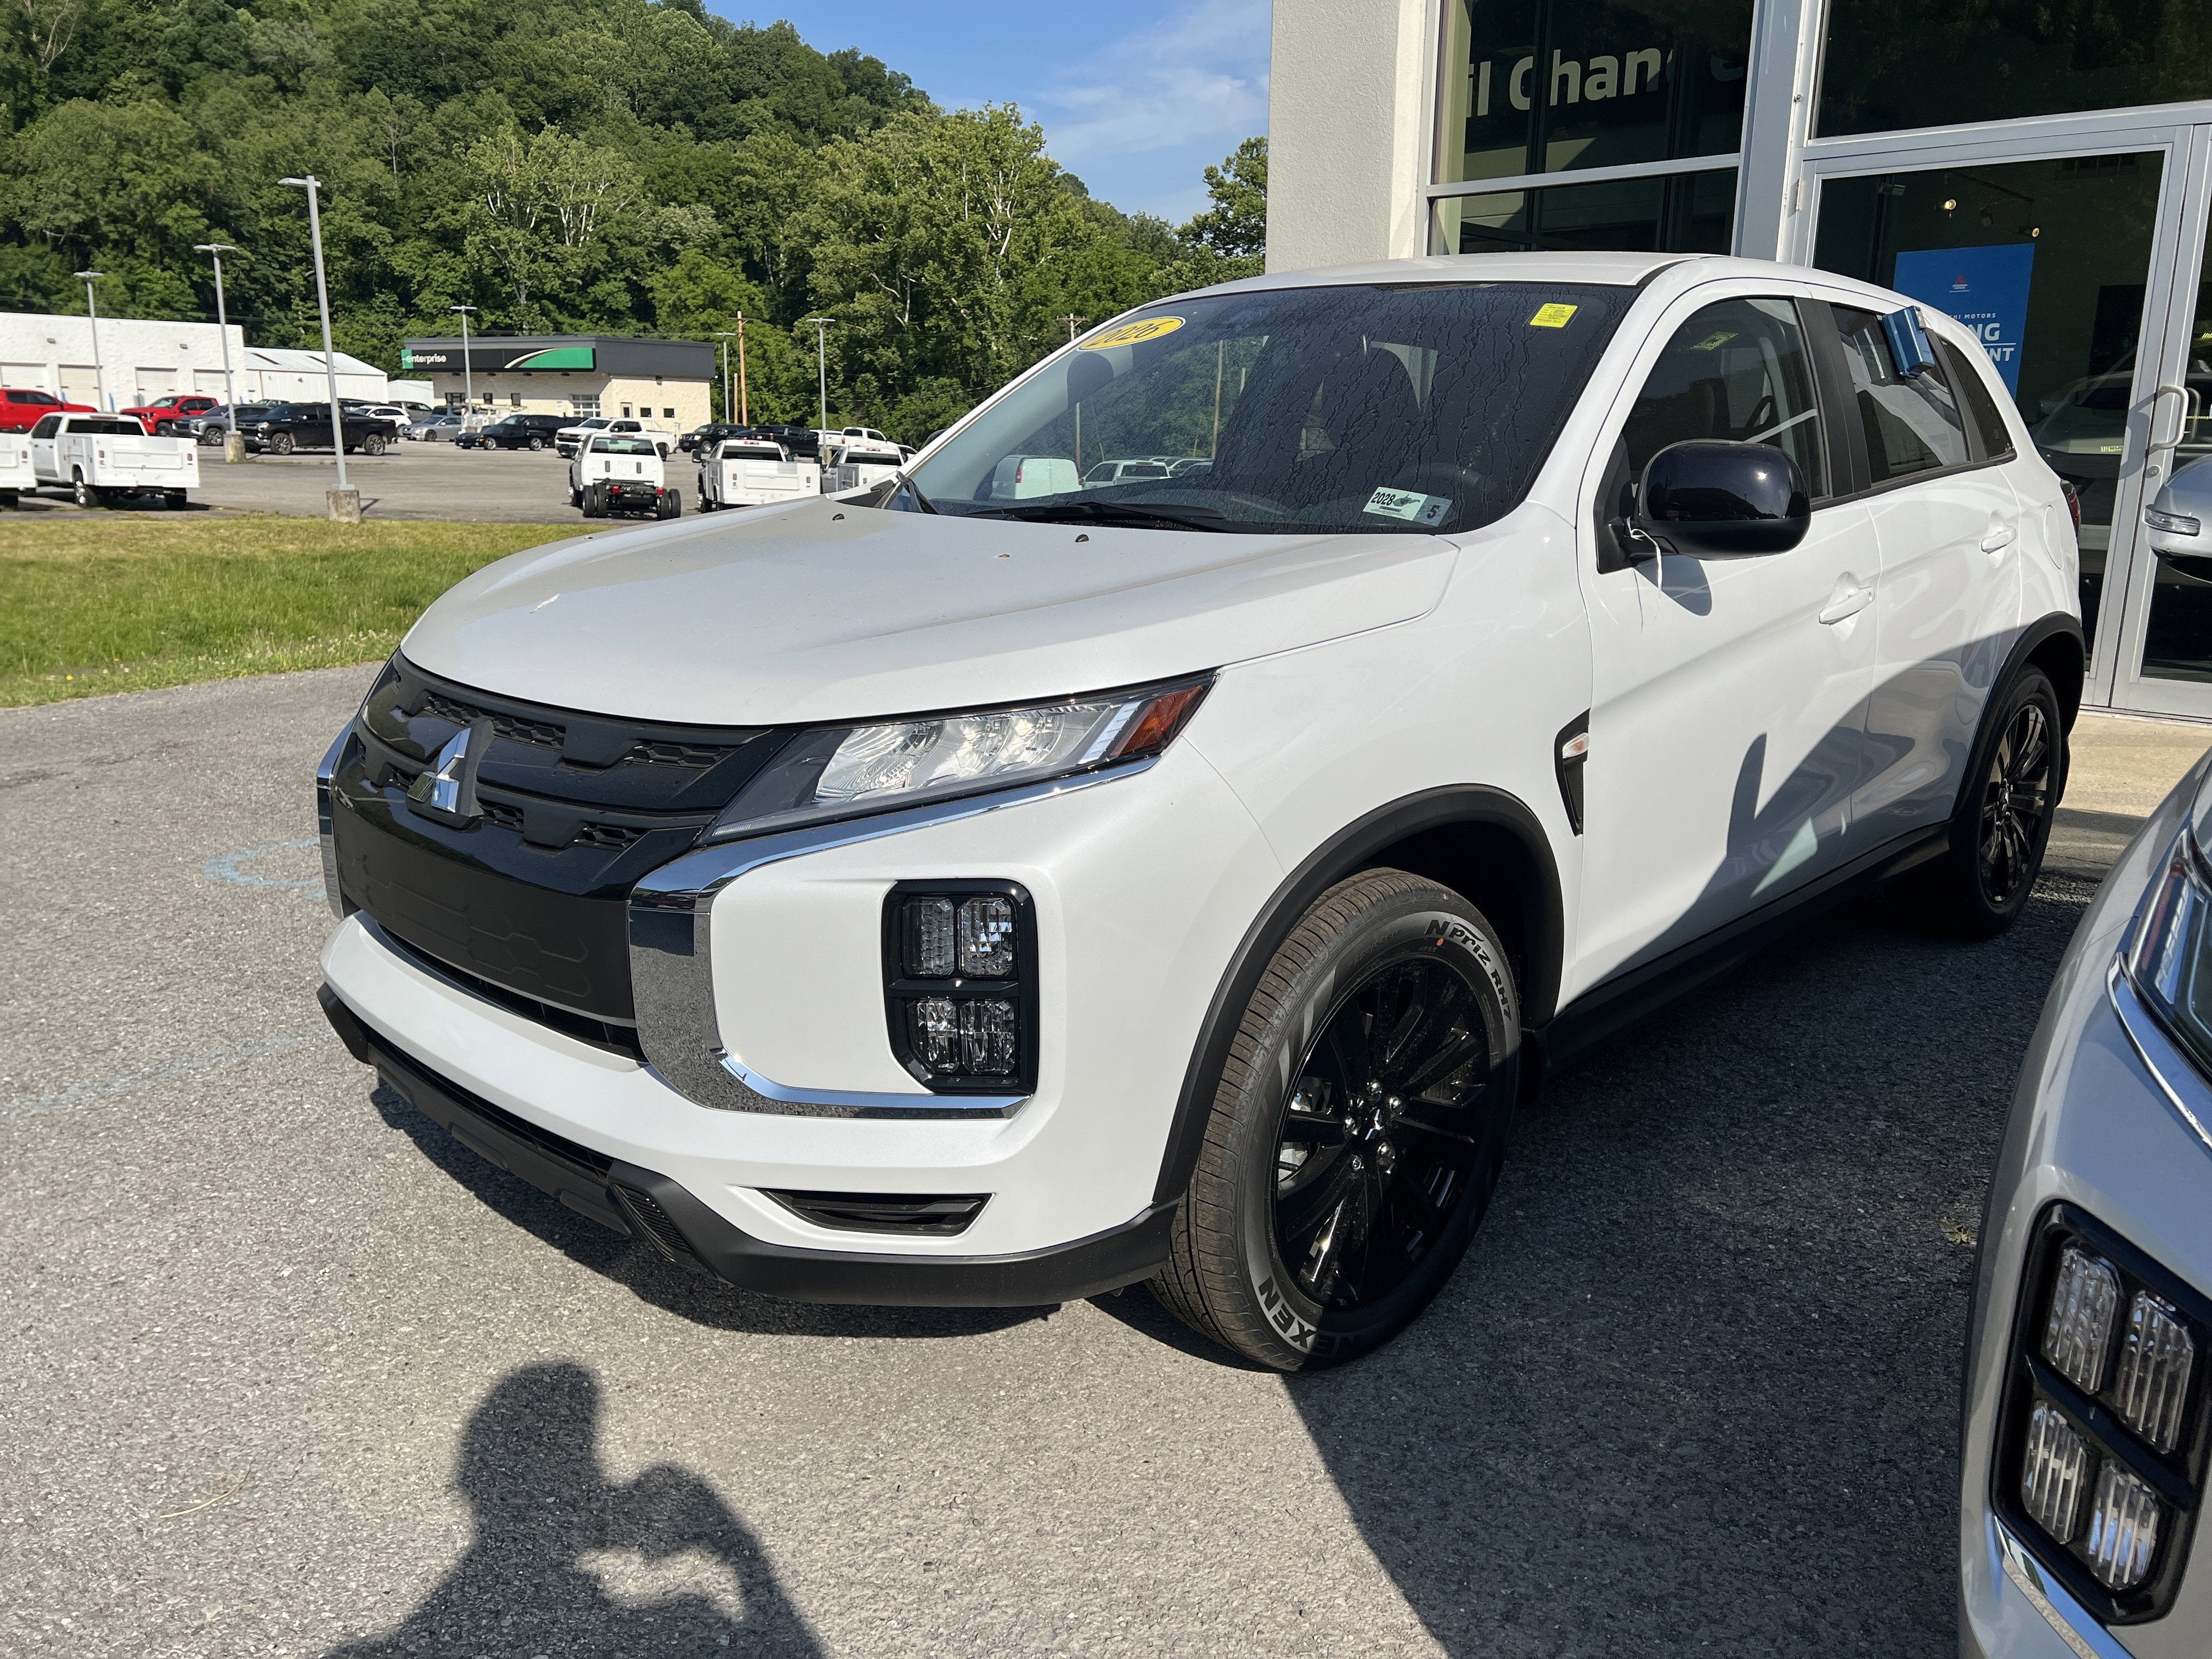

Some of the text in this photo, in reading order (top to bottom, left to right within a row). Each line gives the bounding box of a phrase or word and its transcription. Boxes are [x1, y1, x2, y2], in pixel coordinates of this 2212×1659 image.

[1466, 61, 1491, 117] il
[402, 354, 447, 364] enterprise
[1985, 347, 2015, 362] NT
[1370, 492, 1396, 506] 2028
[1427, 505, 1440, 519] 5
[1491, 968, 1512, 1021] RH7
